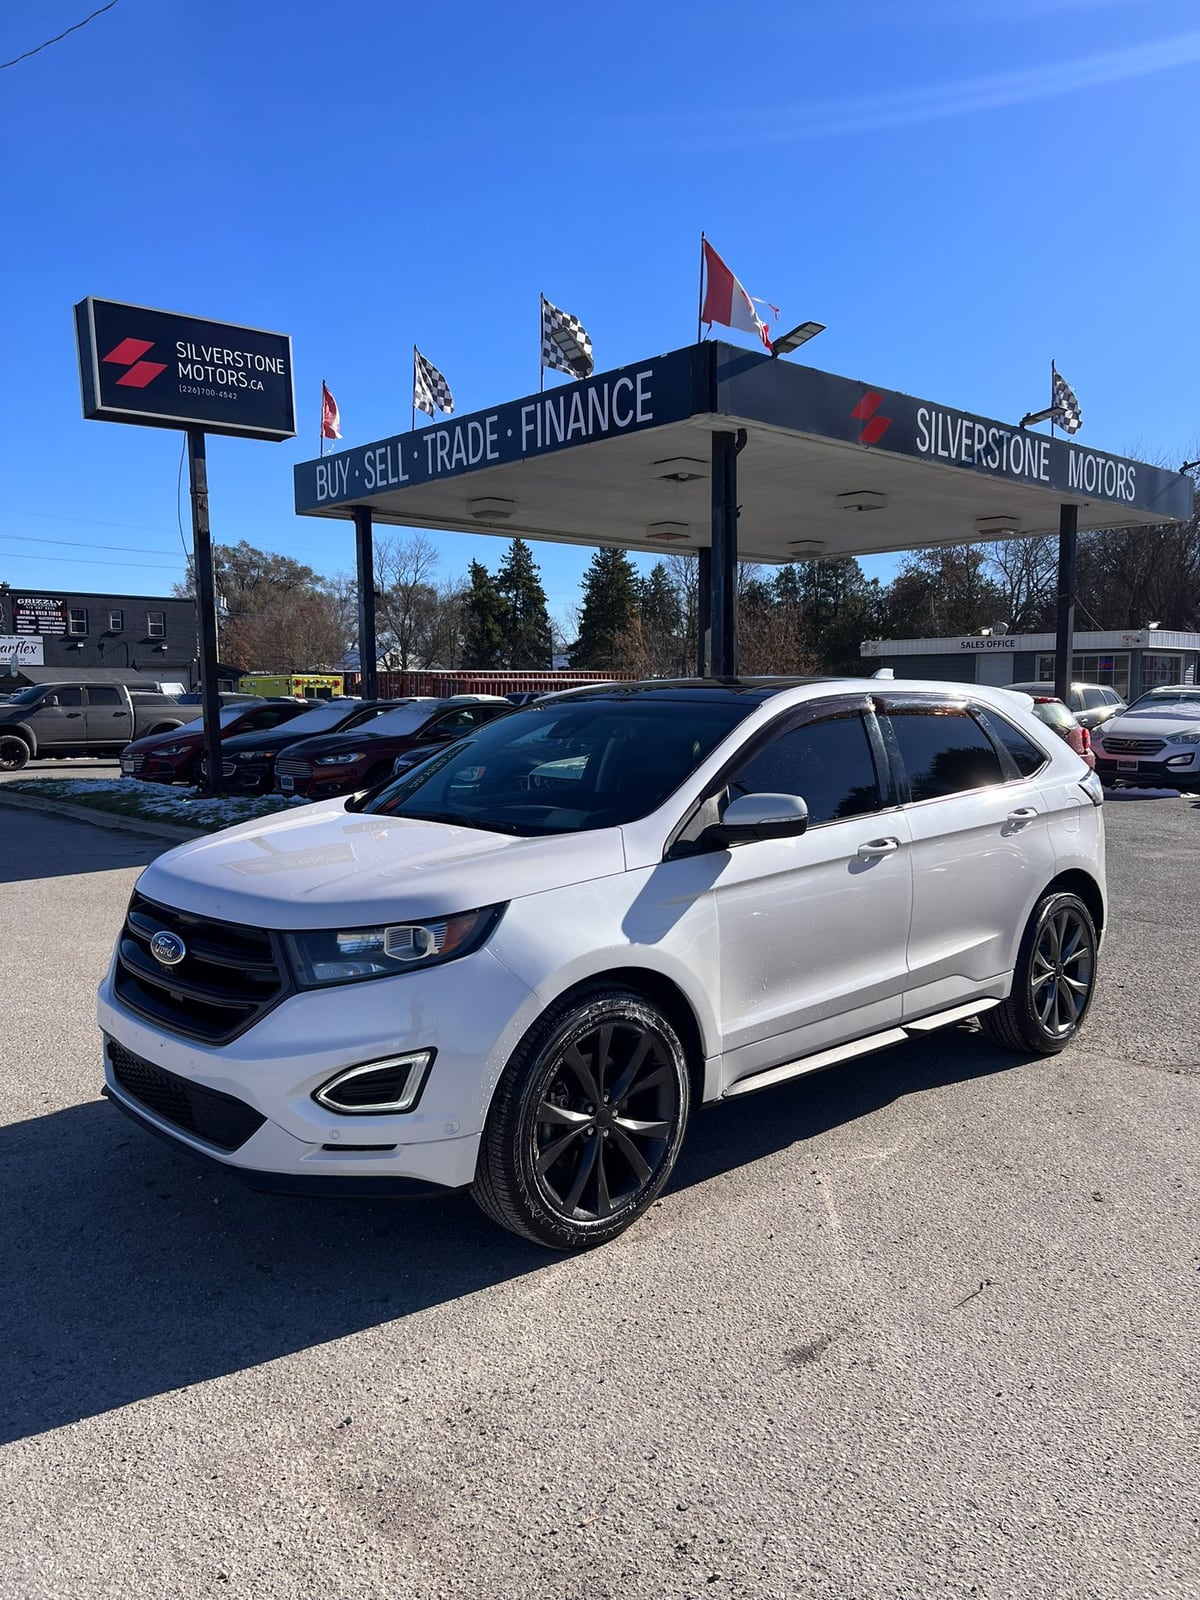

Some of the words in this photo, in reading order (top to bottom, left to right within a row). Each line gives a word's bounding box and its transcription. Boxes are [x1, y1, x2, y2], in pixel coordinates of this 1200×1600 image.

[176, 341, 285, 375] SILVERSTONE
[178, 362, 264, 391] MOTORS.CA
[179, 384, 238, 400] (226)700-4542
[316, 457, 350, 501] BUY
[364, 443, 409, 489] SELL
[423, 415, 499, 474] TRADE
[521, 370, 653, 451] FINANCE
[916, 408, 1050, 481] SILVERSTONE
[1068, 450, 1136, 501] MOTORS
[17, 598, 63, 606] GRIZZLY
[960, 640, 985, 649] SALES
[986, 639, 1015, 648] OFFICE
[154, 936, 176, 958] Ford
